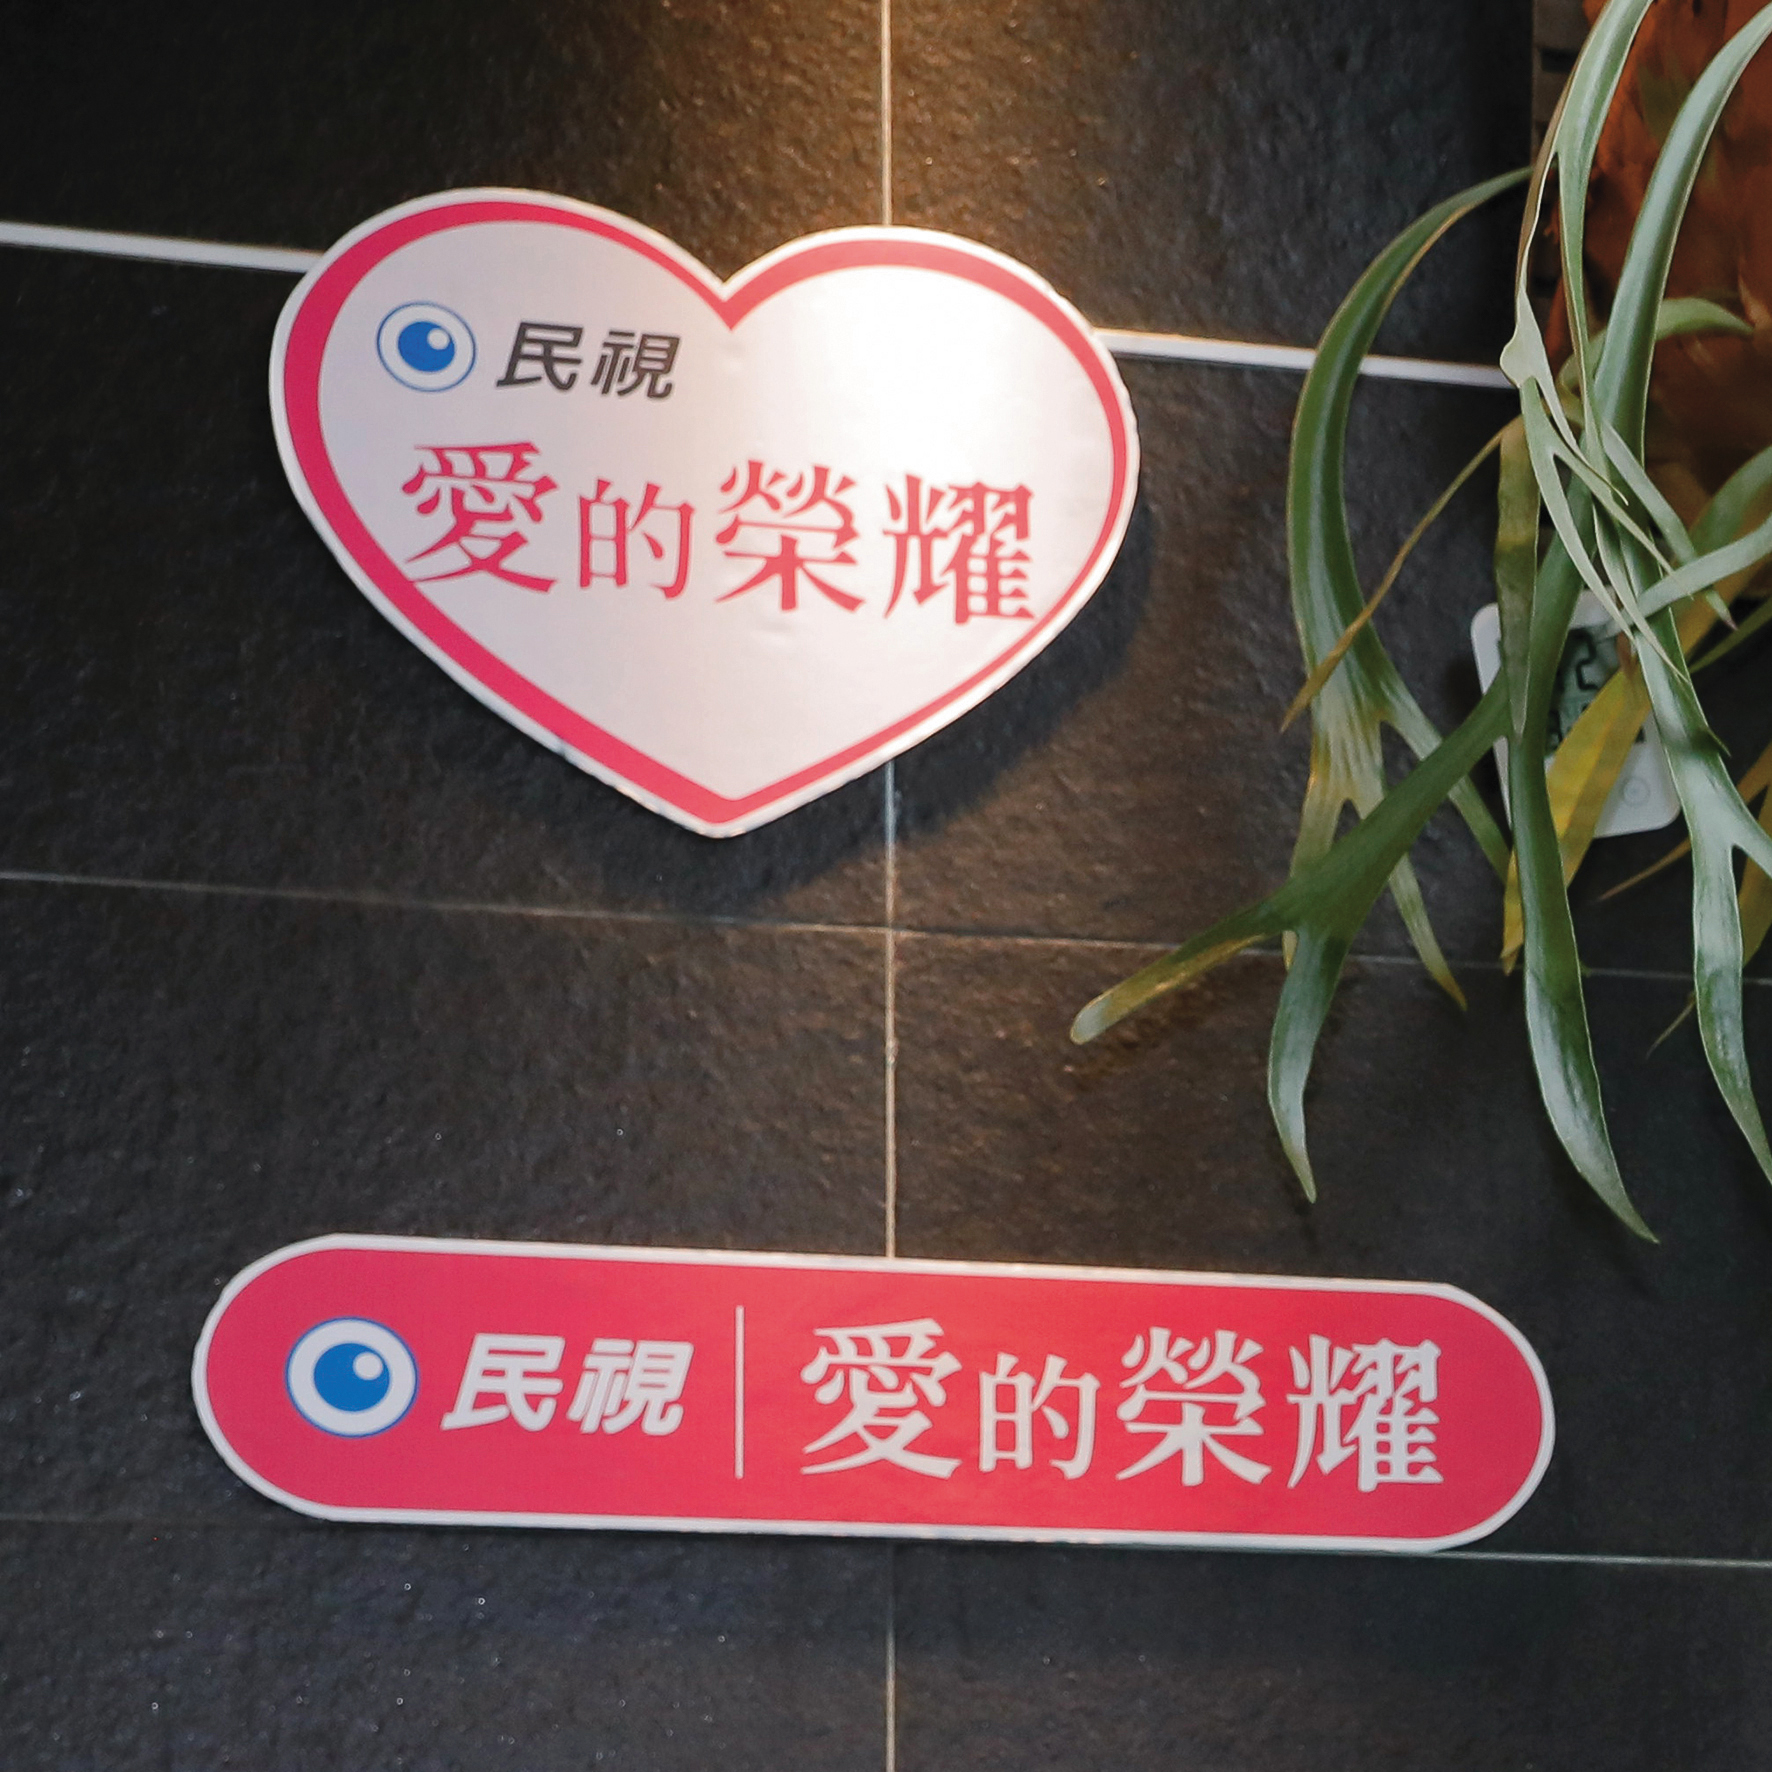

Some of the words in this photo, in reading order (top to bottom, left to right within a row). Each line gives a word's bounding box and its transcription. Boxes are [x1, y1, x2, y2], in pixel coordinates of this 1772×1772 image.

[496, 321, 682, 399] 民視
[401, 441, 1035, 624] 愛的榮耀
[441, 1333, 694, 1436] 民視
[800, 1317, 1444, 1491] 愛的榮耀
